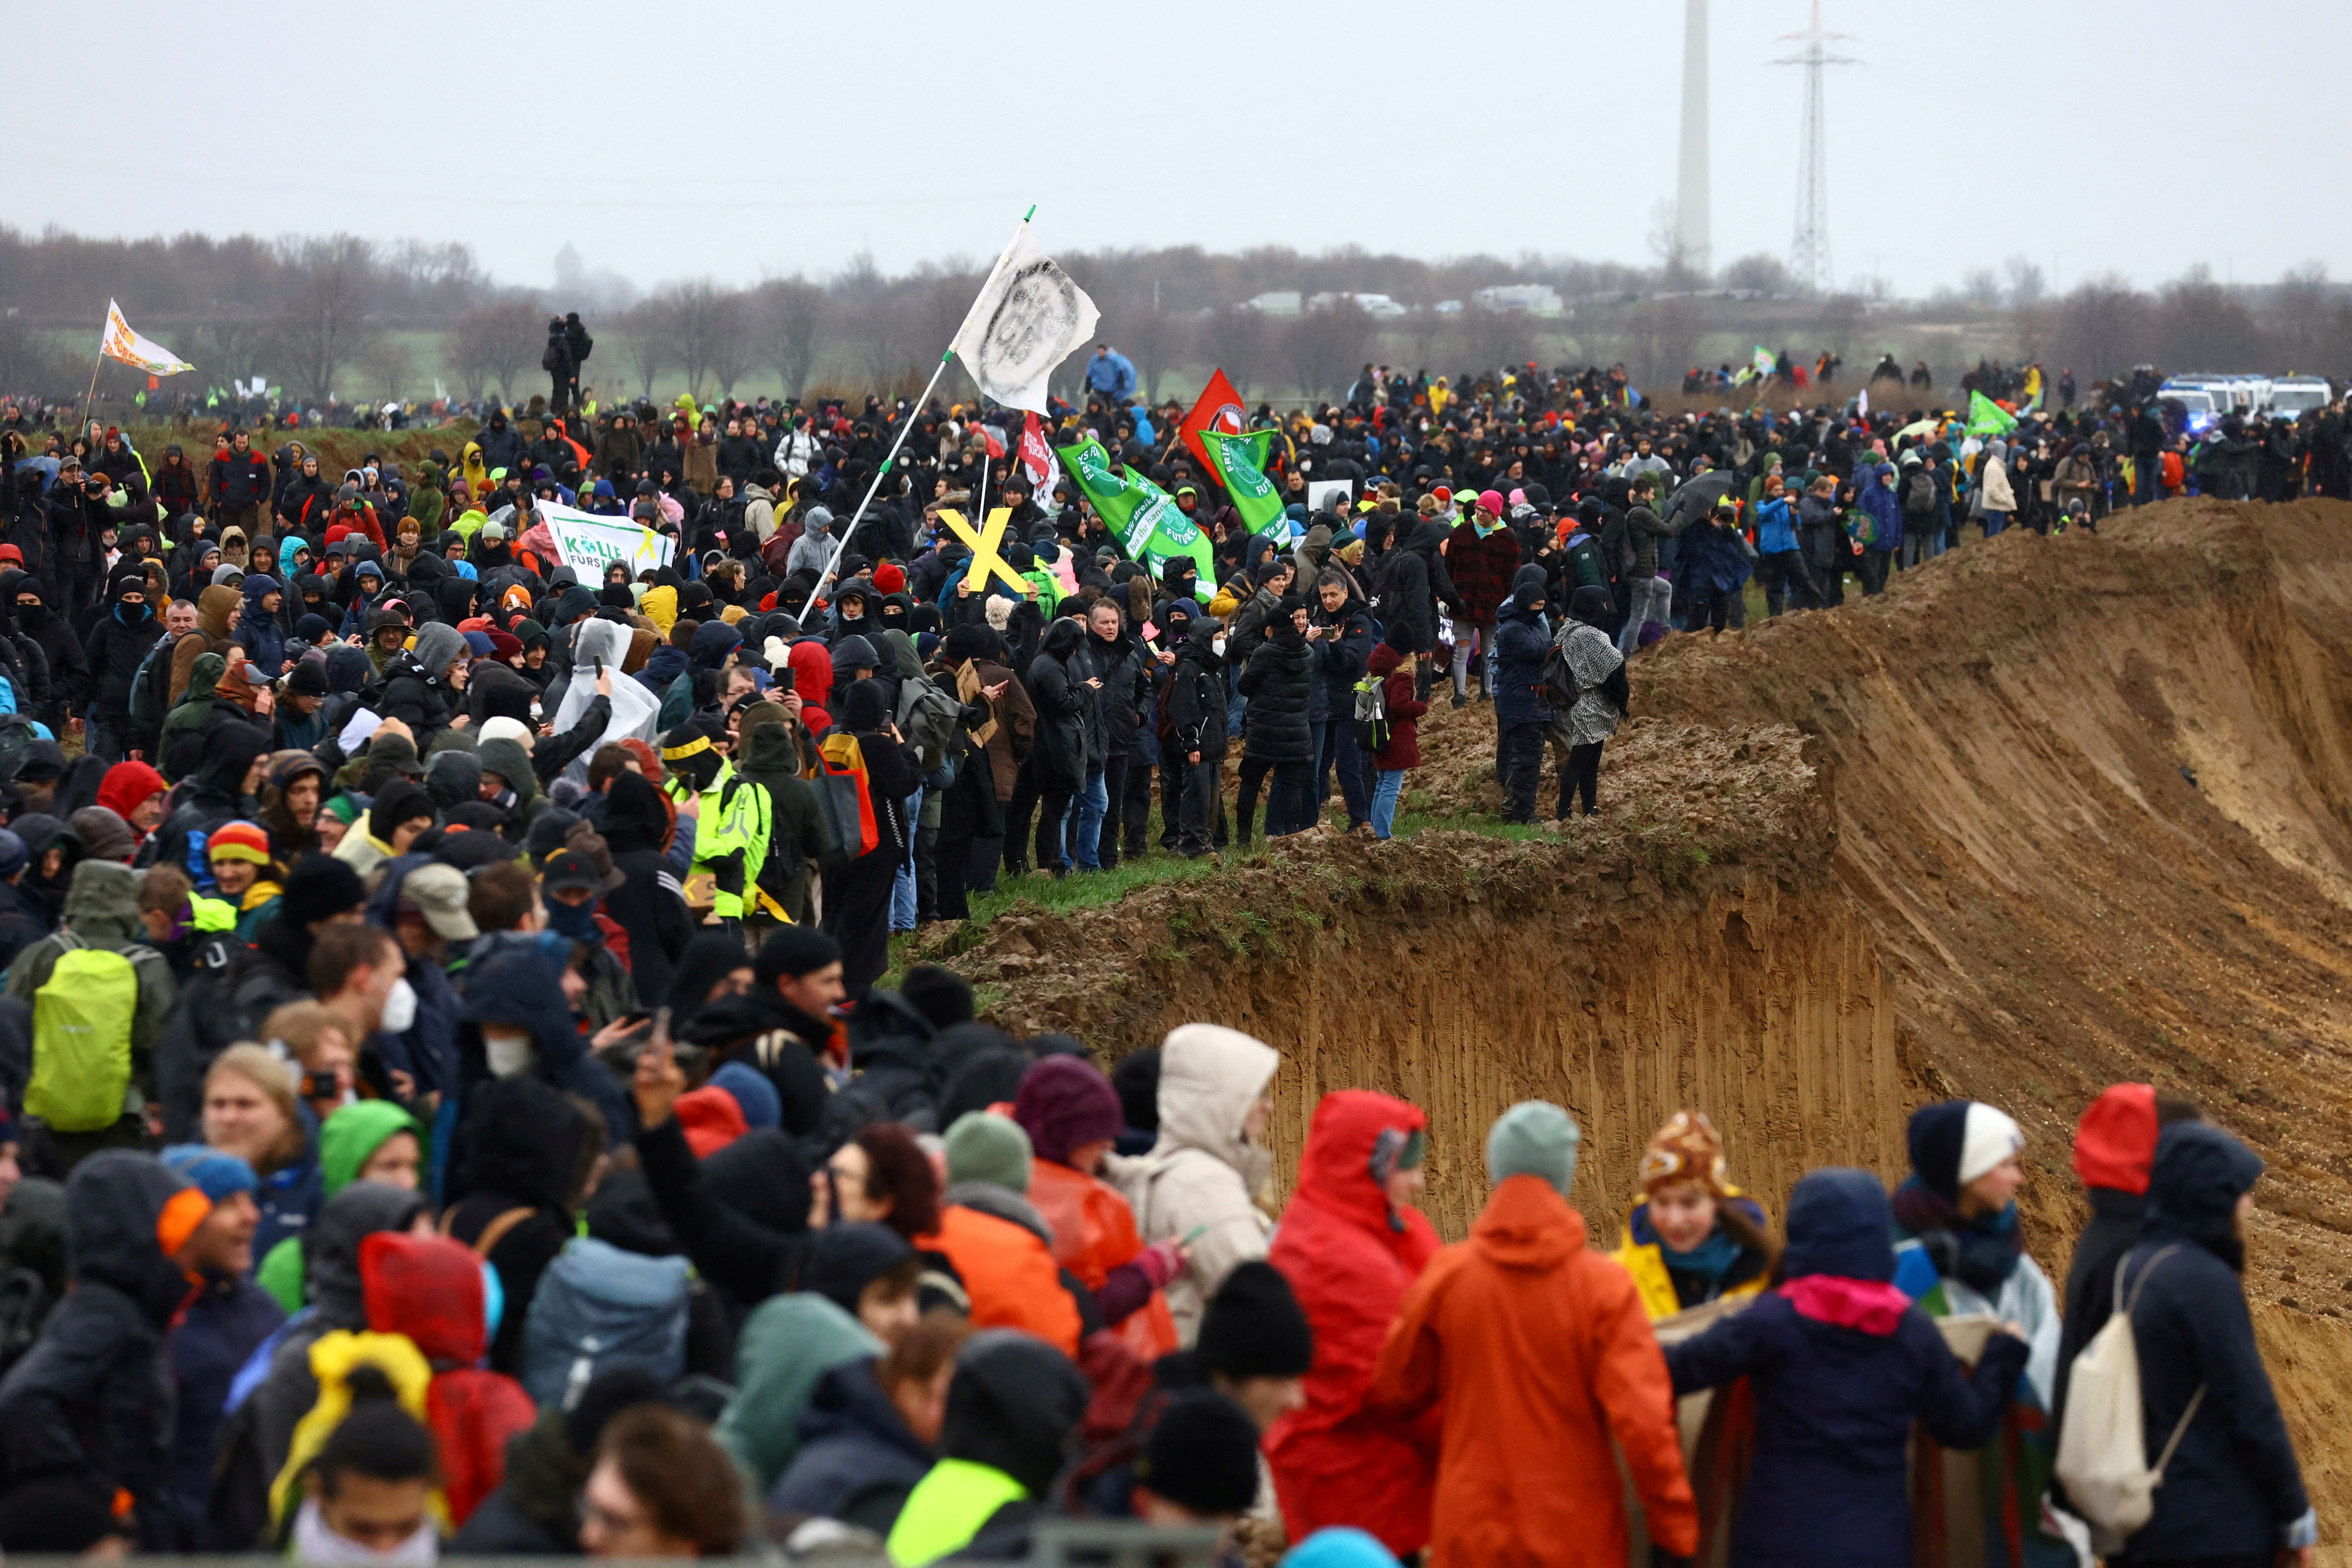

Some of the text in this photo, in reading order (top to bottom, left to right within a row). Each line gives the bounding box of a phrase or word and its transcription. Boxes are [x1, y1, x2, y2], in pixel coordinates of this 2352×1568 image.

[114, 314, 129, 340] ALLE
[1256, 478, 1271, 496] FUT
[1124, 520, 1135, 536] Wir
[1133, 493, 1157, 521] streike
[565, 535, 622, 560] KÖLLE
[1130, 538, 1140, 551] bis
[1137, 524, 1148, 538] Ihr
[1167, 527, 1197, 544] FUTURE
[570, 553, 600, 568] FÜRS
